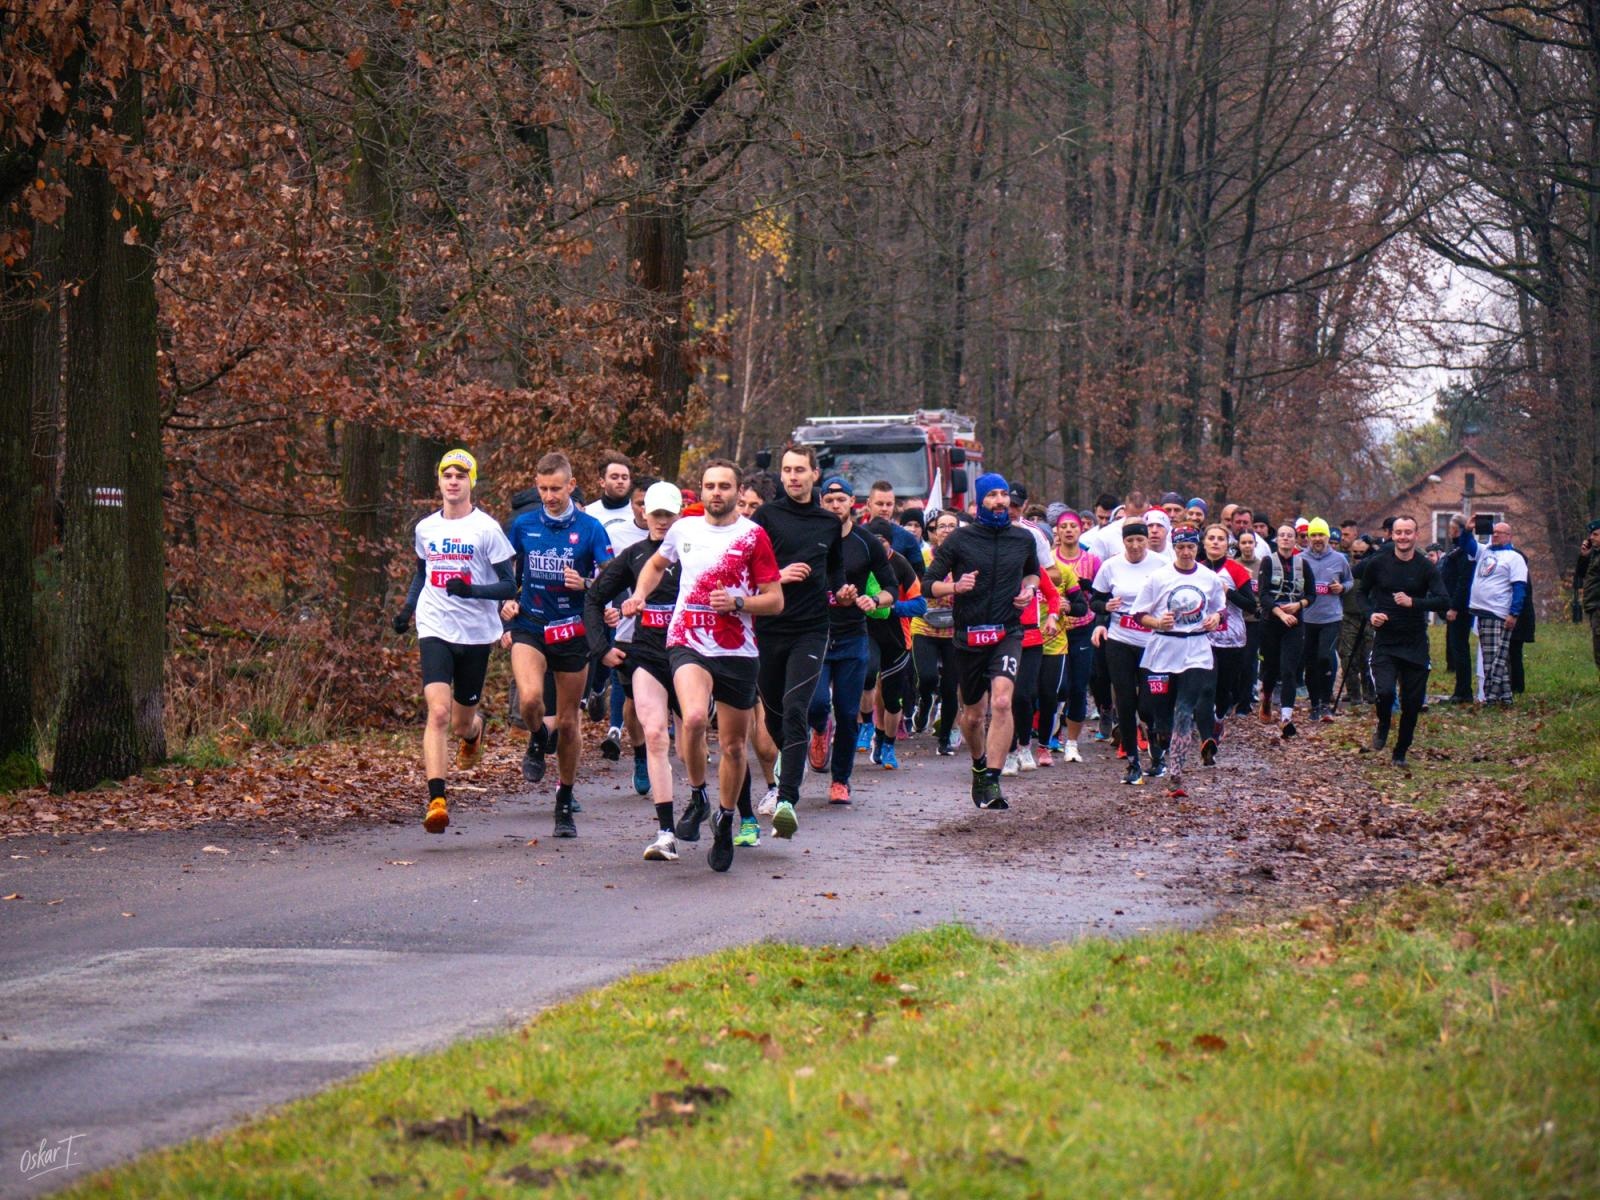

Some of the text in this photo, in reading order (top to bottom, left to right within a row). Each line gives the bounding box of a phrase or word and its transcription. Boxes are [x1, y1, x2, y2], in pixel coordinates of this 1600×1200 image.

[530, 556, 574, 573] SILESIAN
[691, 613, 716, 626] 113
[552, 625, 575, 641] 141
[975, 632, 999, 644] 164
[1001, 655, 1018, 676] 13
